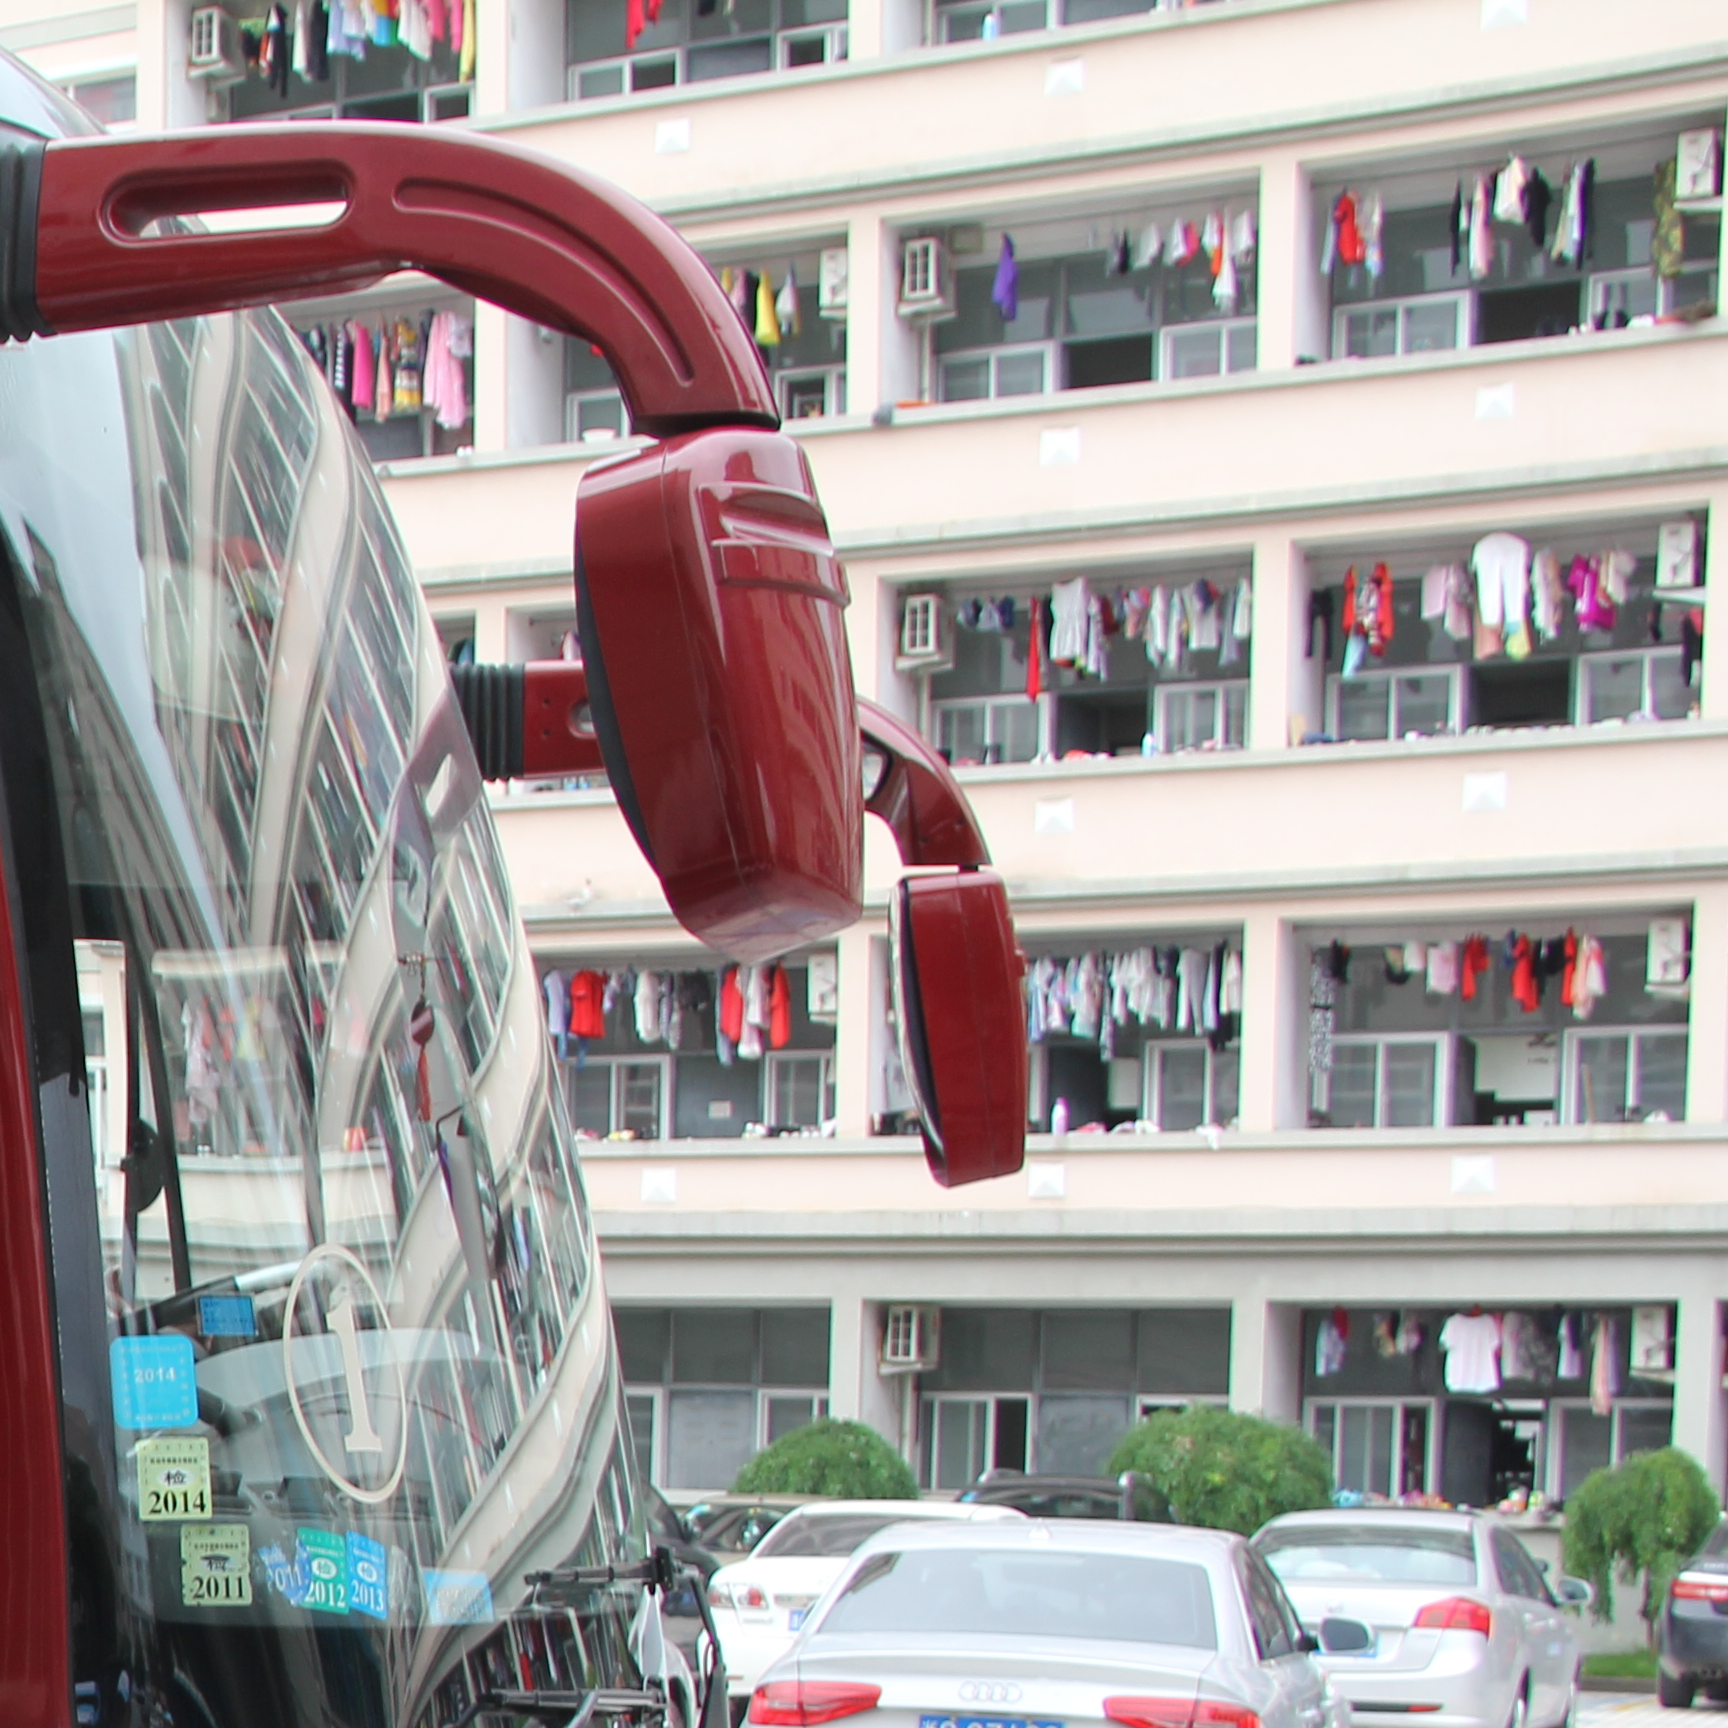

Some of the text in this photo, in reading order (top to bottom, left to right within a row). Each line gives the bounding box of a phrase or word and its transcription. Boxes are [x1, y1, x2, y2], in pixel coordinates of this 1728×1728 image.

[134, 1366, 177, 1383] 2014
[164, 1469, 187, 1487] 检
[148, 1490, 207, 1515] 2014
[192, 1575, 245, 1600] 2011
[305, 1580, 346, 1609] 2012
[350, 1579, 385, 1612] 2013
